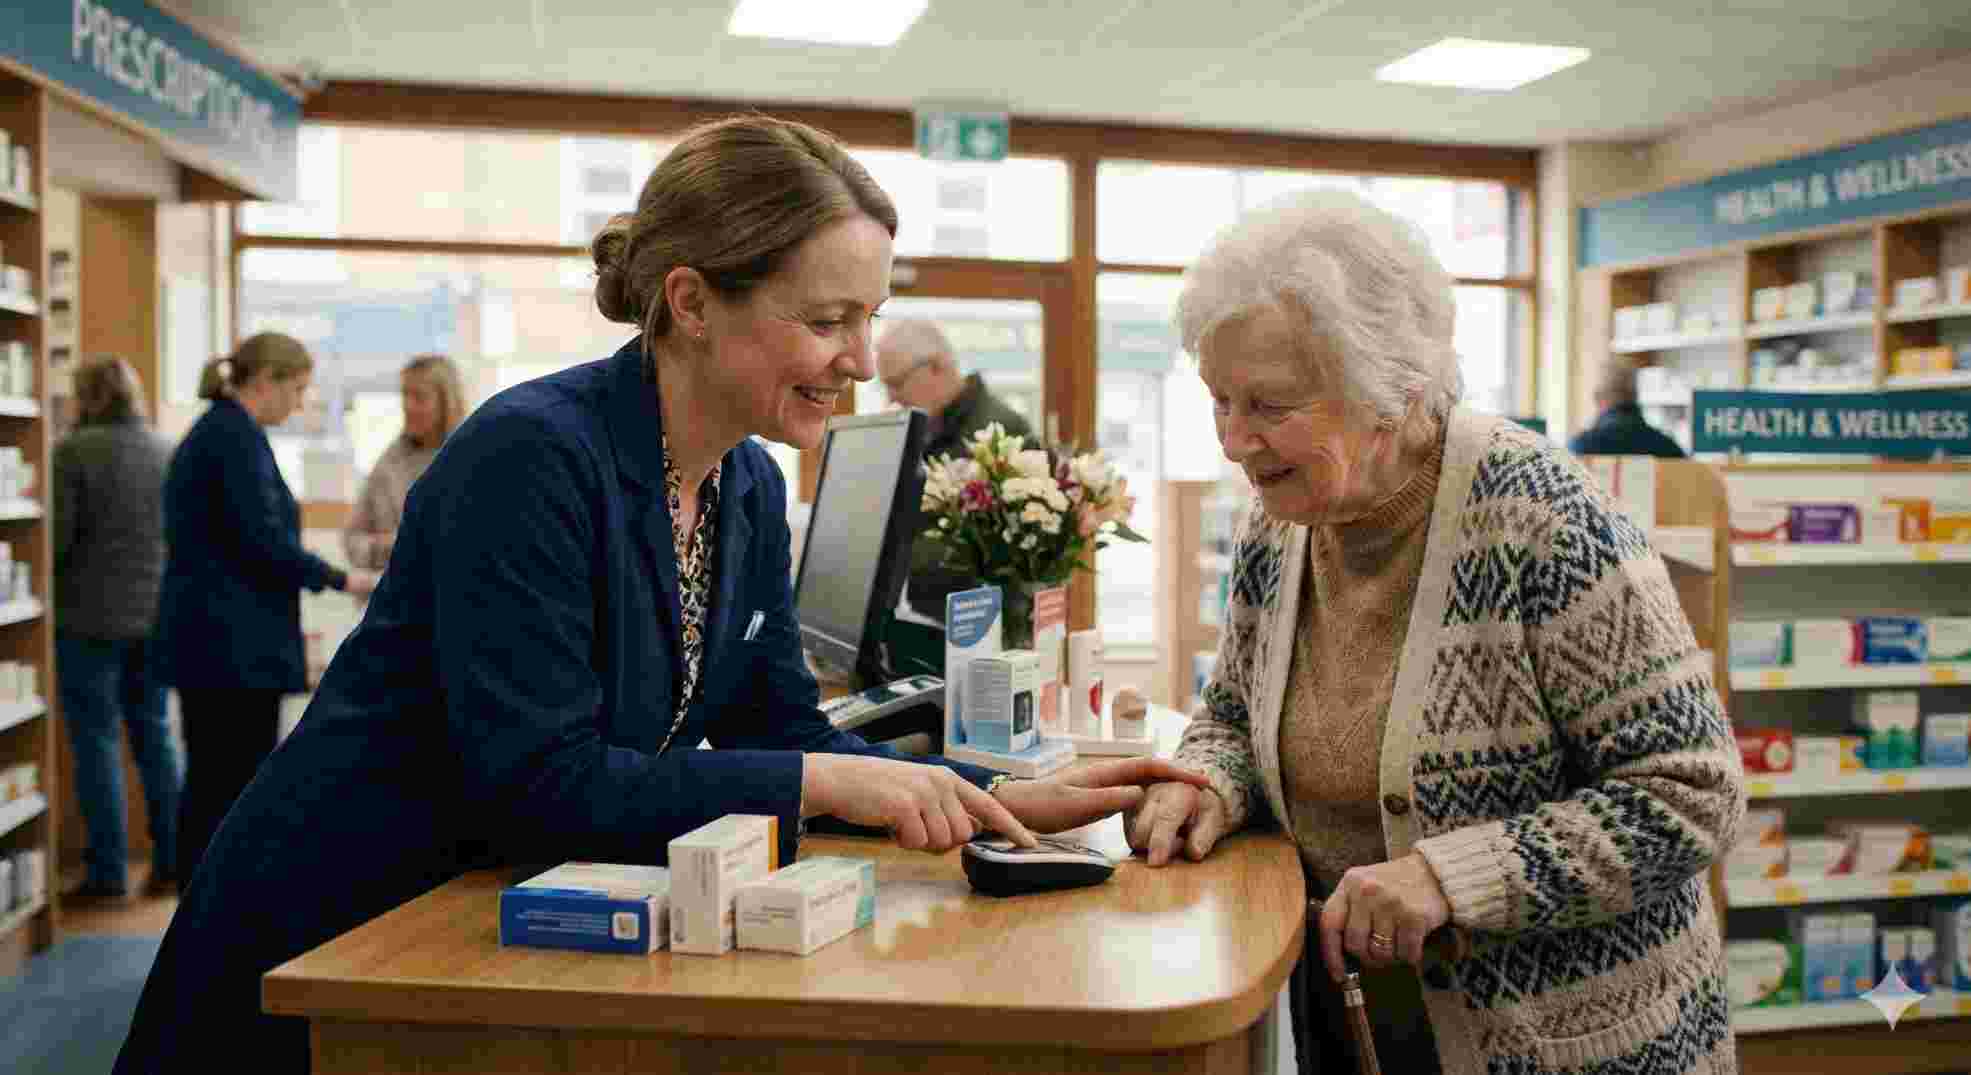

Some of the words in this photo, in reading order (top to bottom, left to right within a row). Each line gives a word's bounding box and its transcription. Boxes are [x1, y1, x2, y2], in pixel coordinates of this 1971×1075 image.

[1703, 408, 1806, 438] HEALTH
[1810, 408, 1834, 438] &
[1838, 408, 1969, 438] WELLNESS
